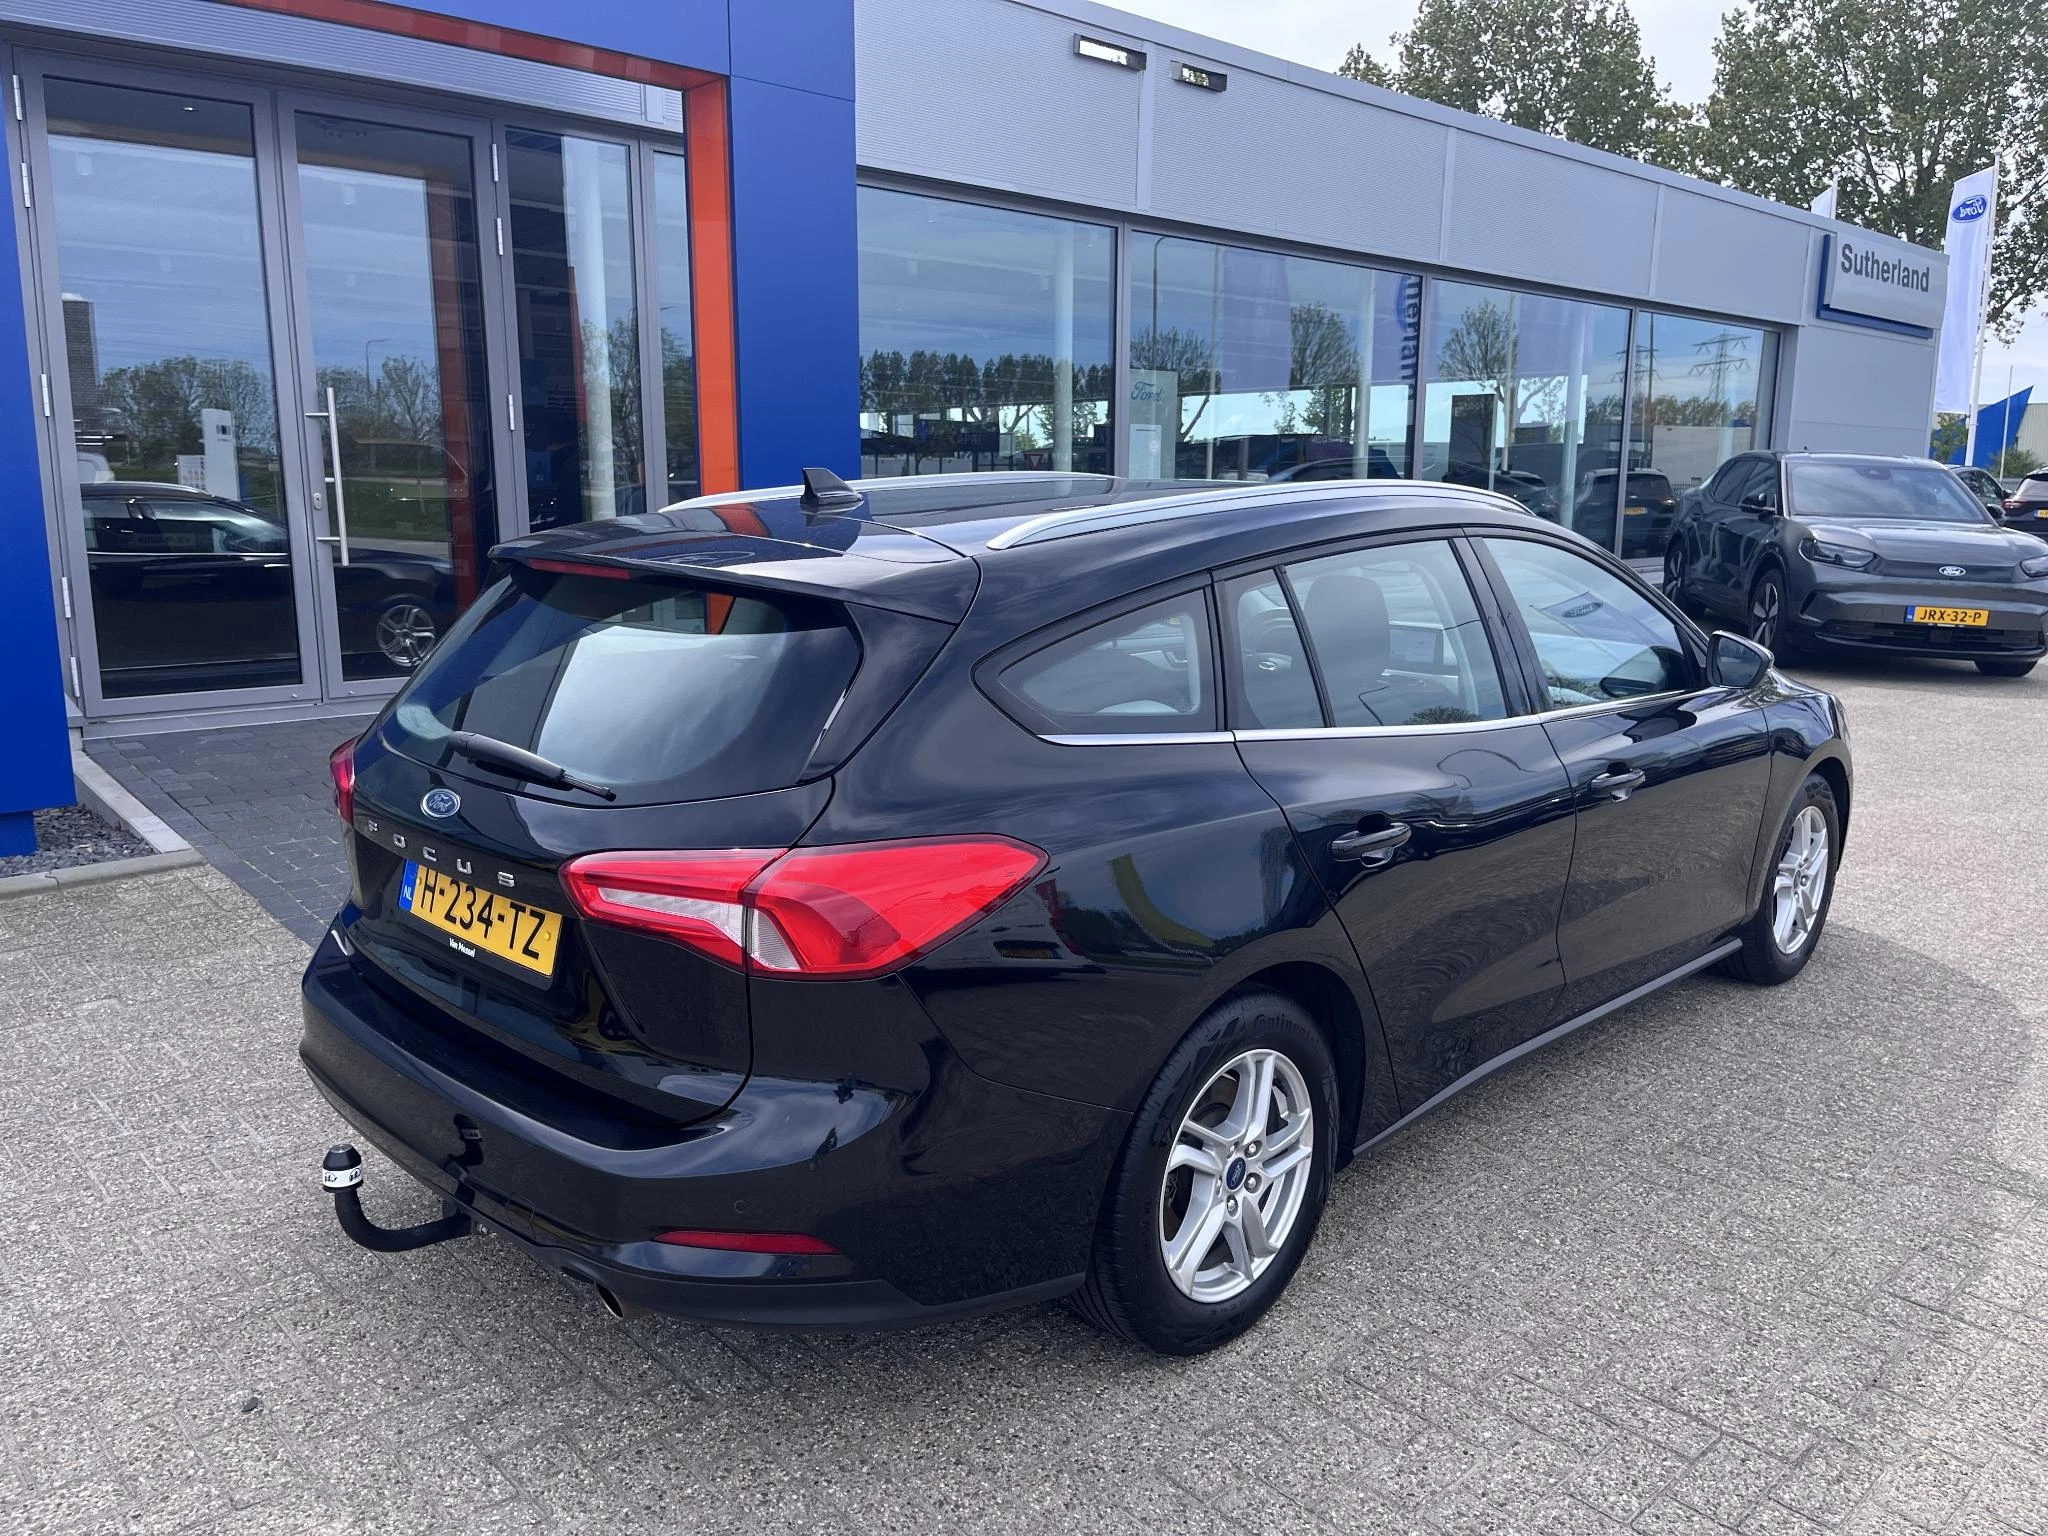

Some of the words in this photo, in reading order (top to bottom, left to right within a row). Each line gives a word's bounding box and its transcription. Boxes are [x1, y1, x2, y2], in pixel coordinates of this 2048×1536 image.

[1841, 243, 1930, 293] Sutherland
[1131, 381, 1163, 402] Ford
[1919, 608, 1982, 623] JRX-32-P
[367, 819, 515, 888] FOCUS
[420, 867, 546, 960] H-234-TZ
